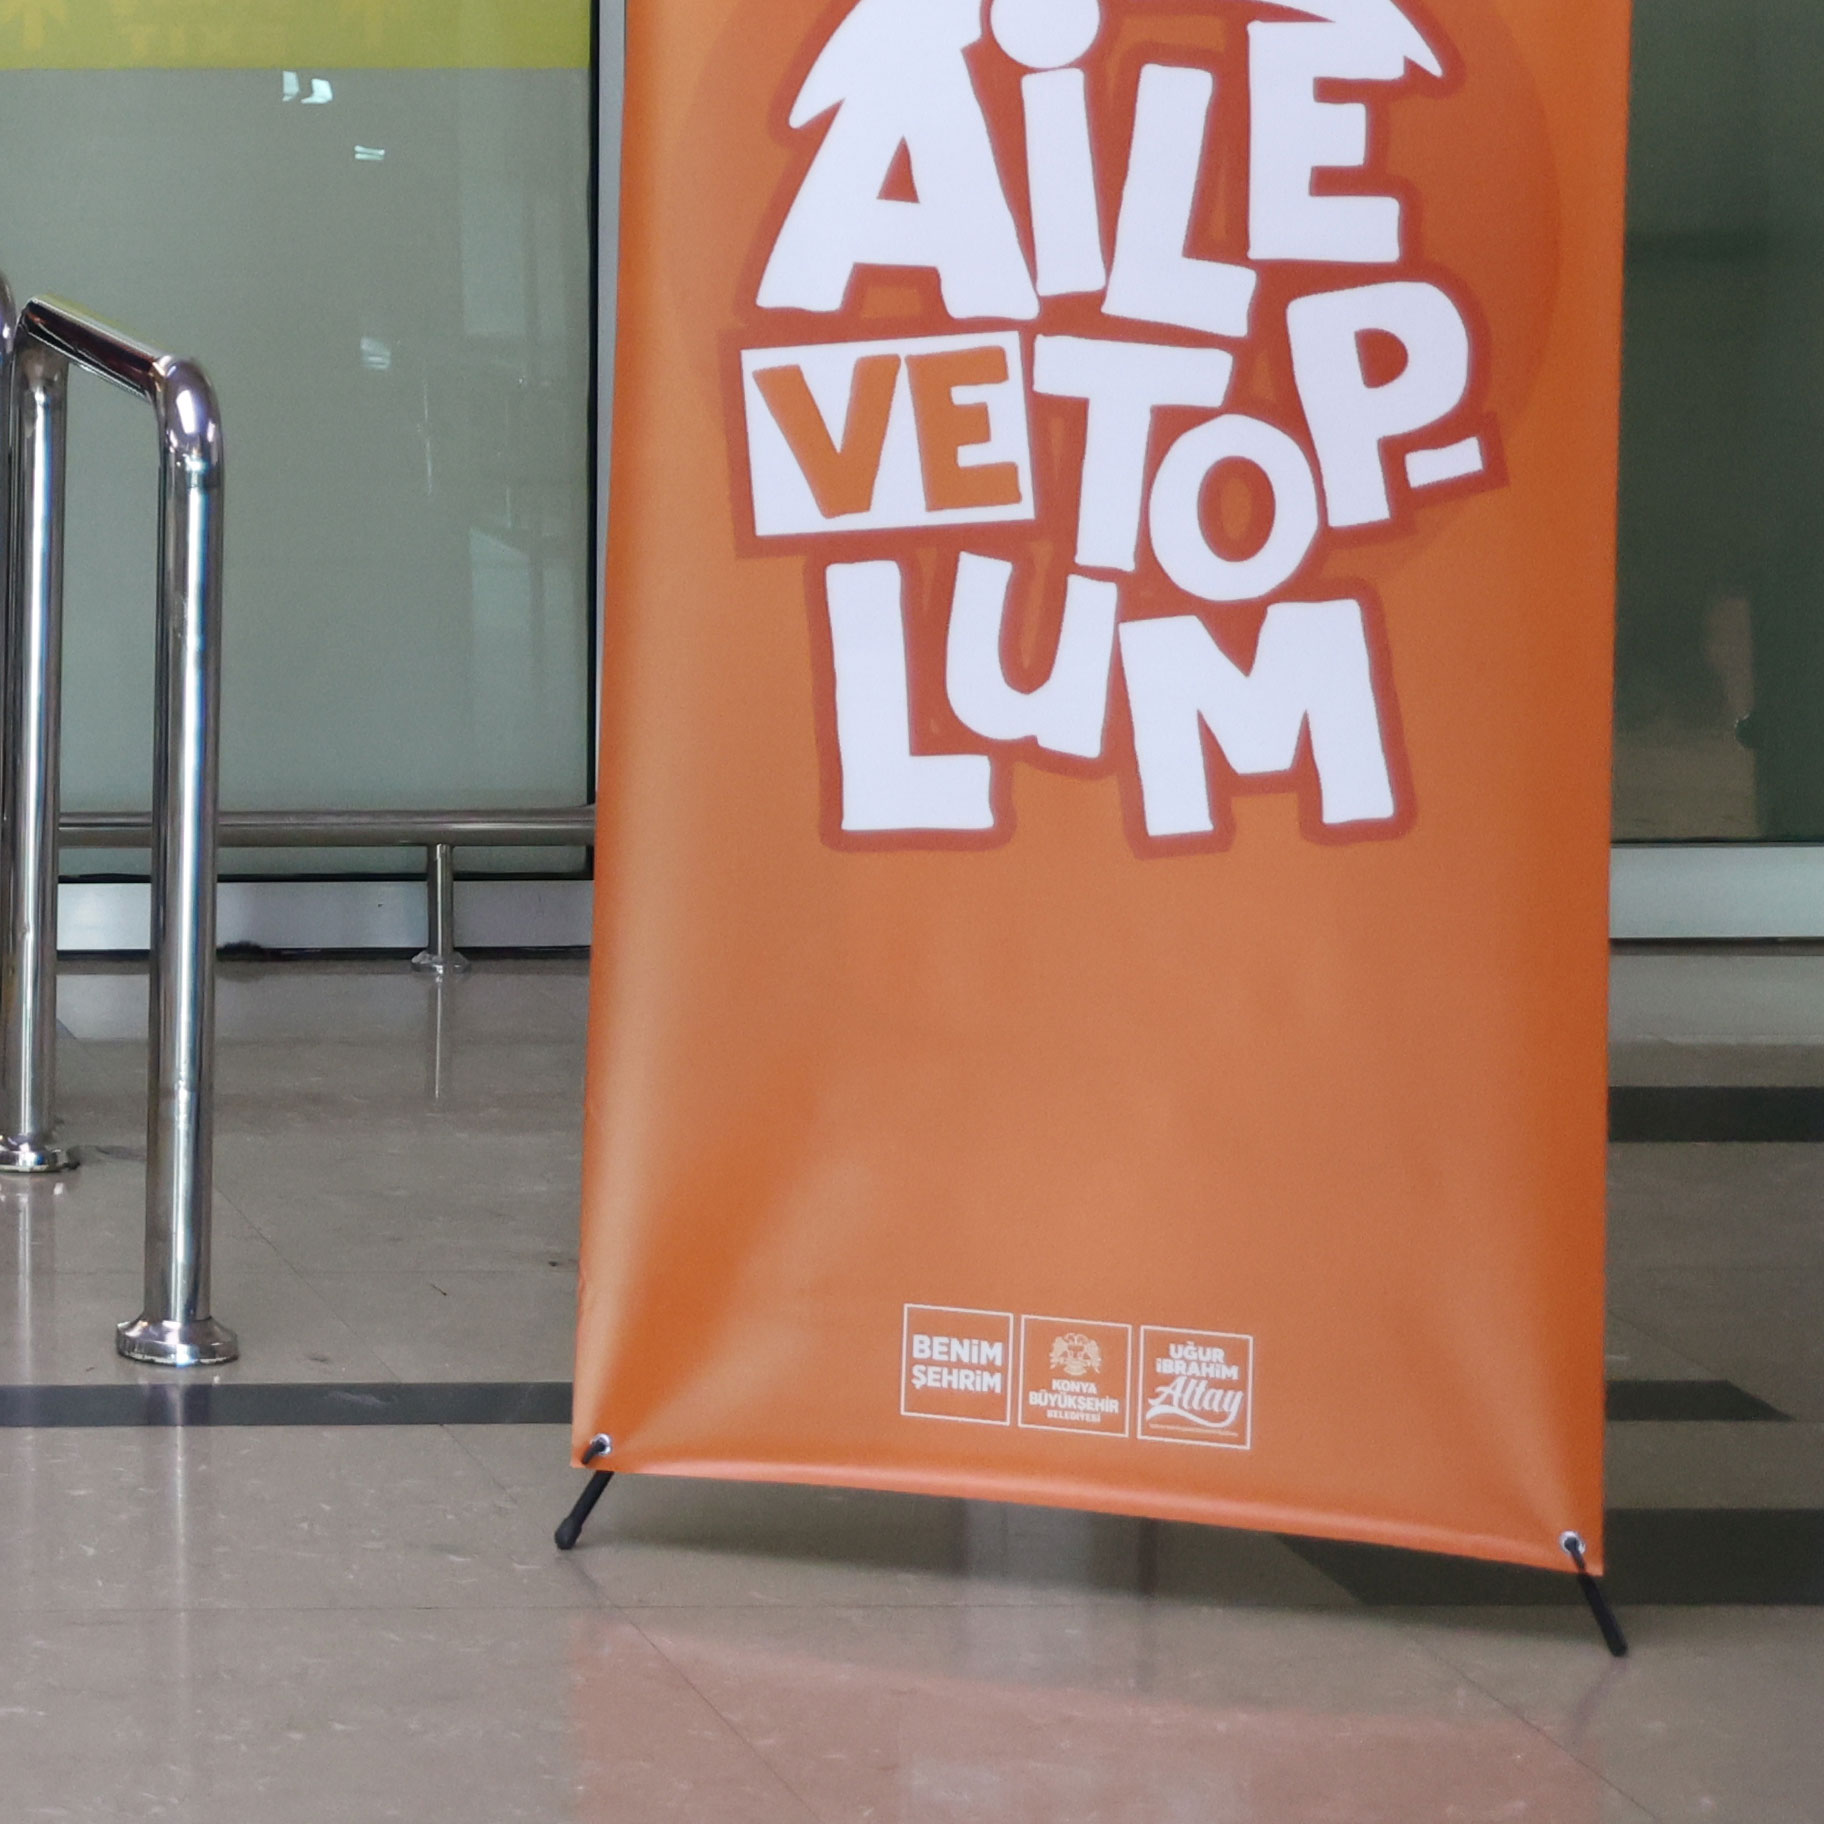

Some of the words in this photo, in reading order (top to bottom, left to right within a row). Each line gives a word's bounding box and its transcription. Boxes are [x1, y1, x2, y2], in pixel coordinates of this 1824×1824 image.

[752, 344, 1024, 521] VE
[824, 551, 1395, 836] LUM
[912, 1333, 1004, 1367] BENİM
[1168, 1339, 1226, 1364] UĞUR
[911, 1363, 1003, 1395] ŞEHRİM
[1155, 1356, 1240, 1382] İBRAHİM
[1028, 1389, 1120, 1416] BÜYÜKŞEHİR
[1050, 1378, 1098, 1395] KONYA
[1146, 1374, 1245, 1422] Altay
